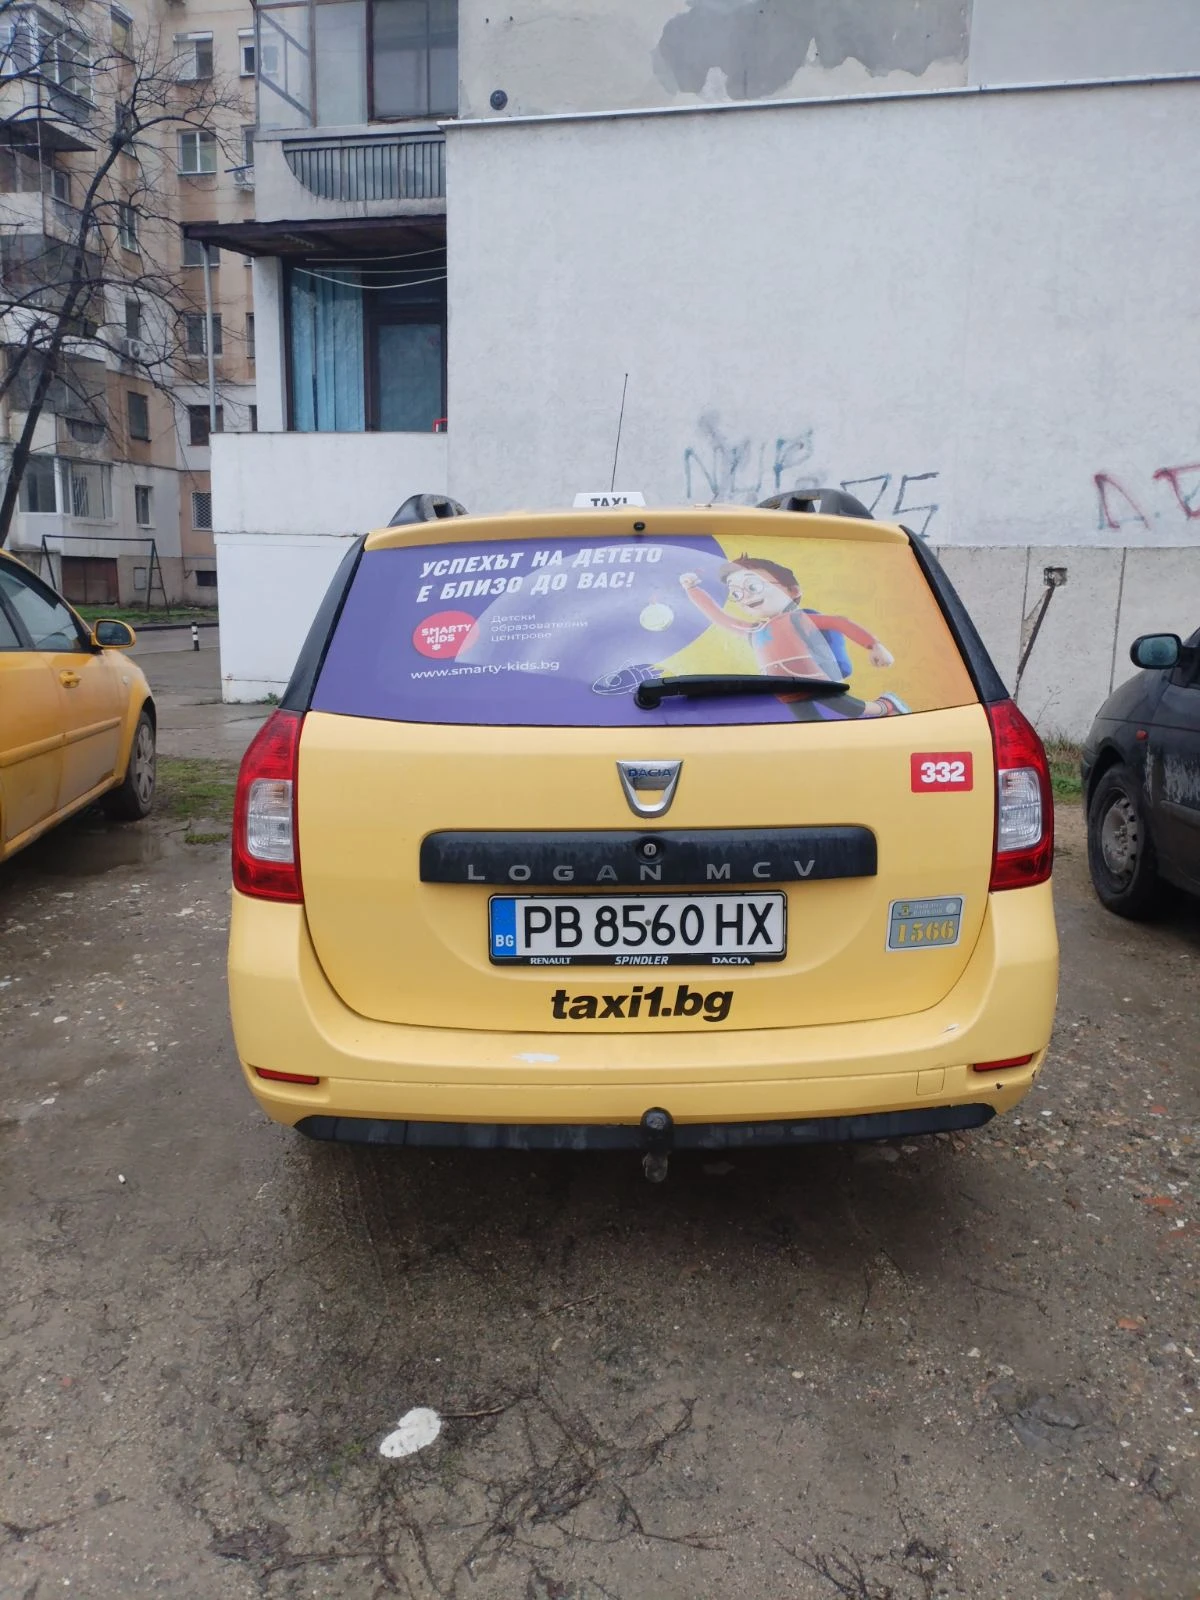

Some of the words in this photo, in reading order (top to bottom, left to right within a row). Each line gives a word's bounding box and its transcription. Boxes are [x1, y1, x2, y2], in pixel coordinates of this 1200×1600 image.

[419, 552, 524, 578] УСПЕХЪТ
[531, 549, 564, 568] НА
[572, 546, 664, 568] ДЕТЕТО
[416, 586, 431, 603] Е
[440, 576, 525, 600] БЛИЗО
[530, 573, 568, 596] ДО
[577, 571, 635, 590] ВАС!
[491, 614, 536, 623] Детски
[421, 623, 472, 637] SMARTY
[426, 632, 455, 645] KIDS
[411, 661, 560, 680] www.smarty-kids.bg
[628, 766, 672, 779] DACIA
[920, 761, 965, 783] 332
[467, 864, 662, 882] LOGAN
[706, 860, 815, 880] MCV
[524, 905, 583, 948] PB
[594, 904, 704, 947] 8560
[715, 902, 774, 946] HX
[898, 920, 954, 944] 1566
[495, 934, 514, 947] BG
[615, 956, 669, 965] SPINDLER
[712, 956, 750, 964] DACIA
[551, 985, 734, 1022] taxi1.bg
